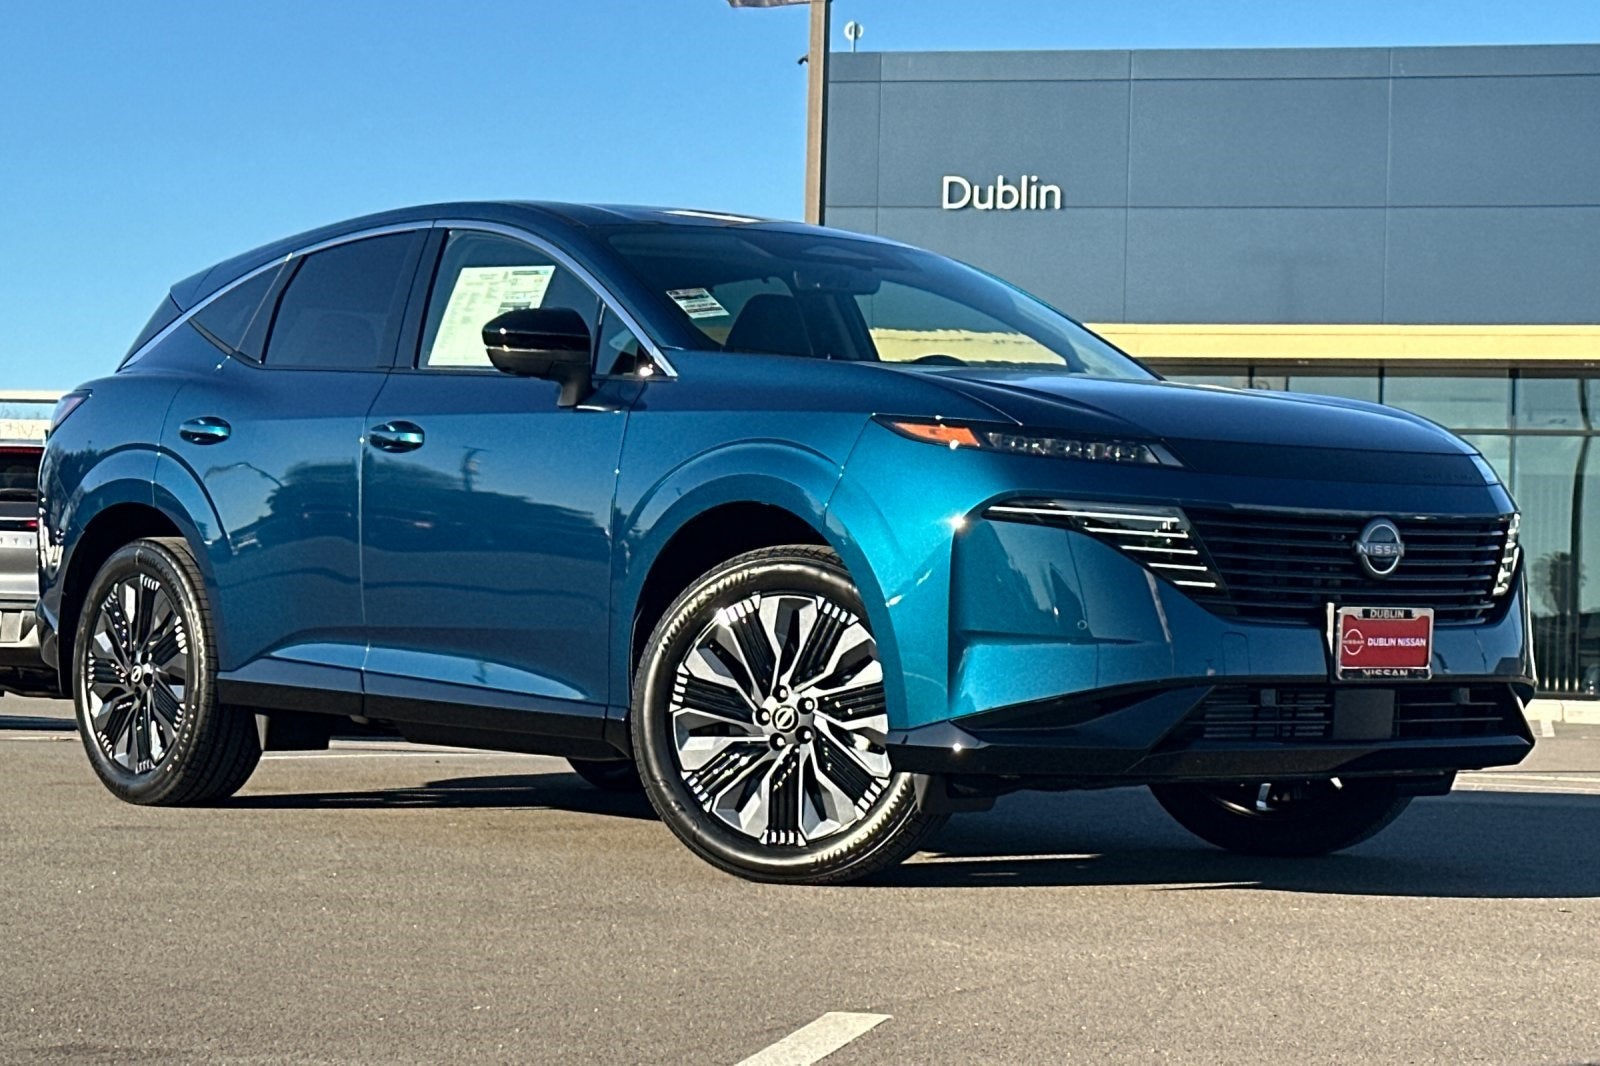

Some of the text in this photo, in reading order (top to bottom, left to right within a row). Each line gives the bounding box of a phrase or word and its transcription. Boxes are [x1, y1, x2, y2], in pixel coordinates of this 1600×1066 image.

[943, 174, 1062, 210] Dublin
[1358, 544, 1405, 555] NISSAN
[1370, 609, 1405, 618] DUBLIN
[1367, 638, 1427, 647] DUBLIN NISSAN
